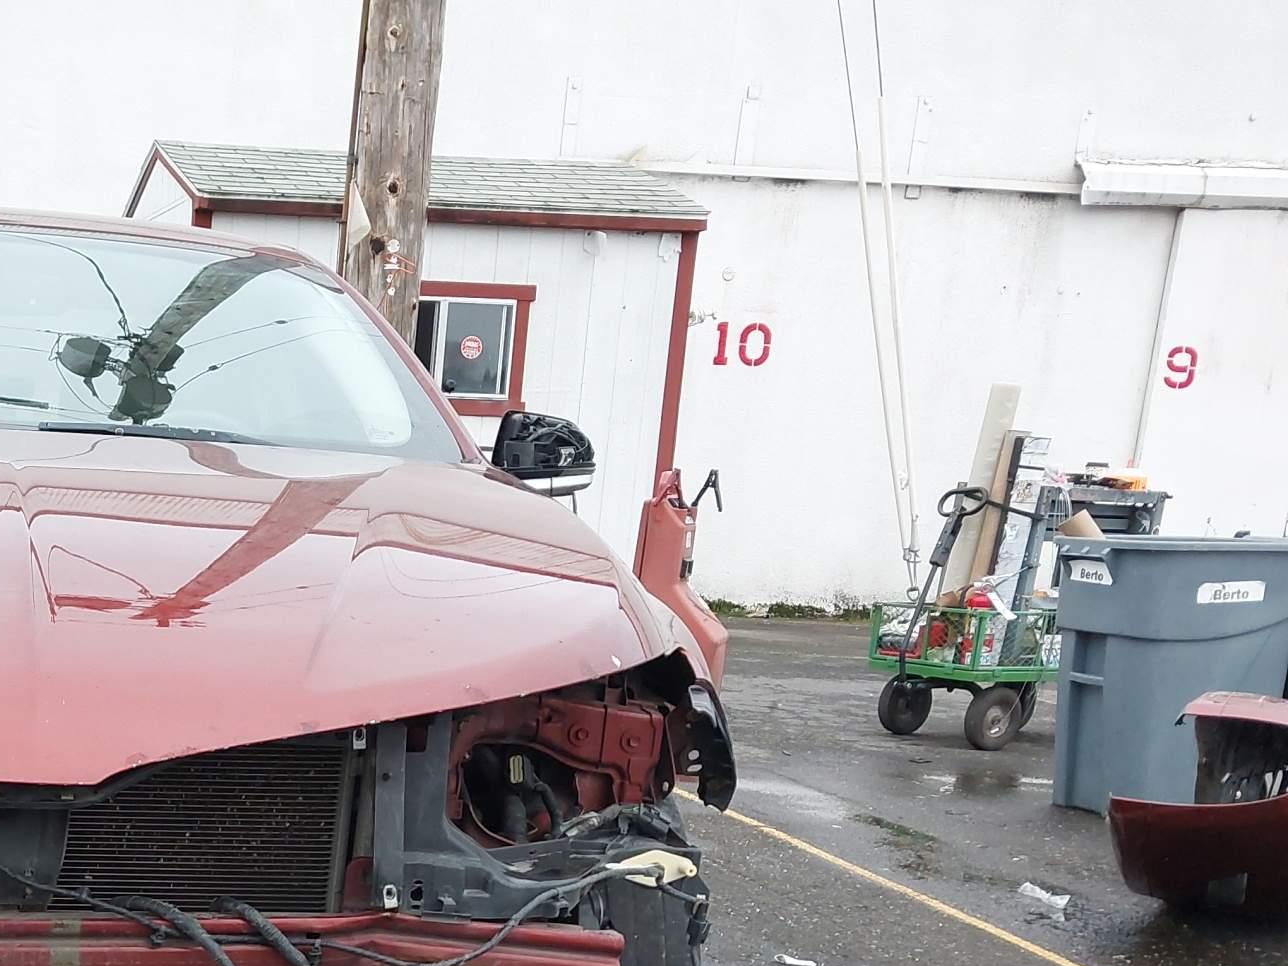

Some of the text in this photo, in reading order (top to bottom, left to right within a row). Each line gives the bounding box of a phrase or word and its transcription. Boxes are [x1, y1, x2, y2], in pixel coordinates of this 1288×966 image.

[712, 321, 772, 367] 10
[1163, 346, 1198, 390] 9
[1079, 567, 1105, 582] Berto
[1212, 588, 1250, 601] Berto
